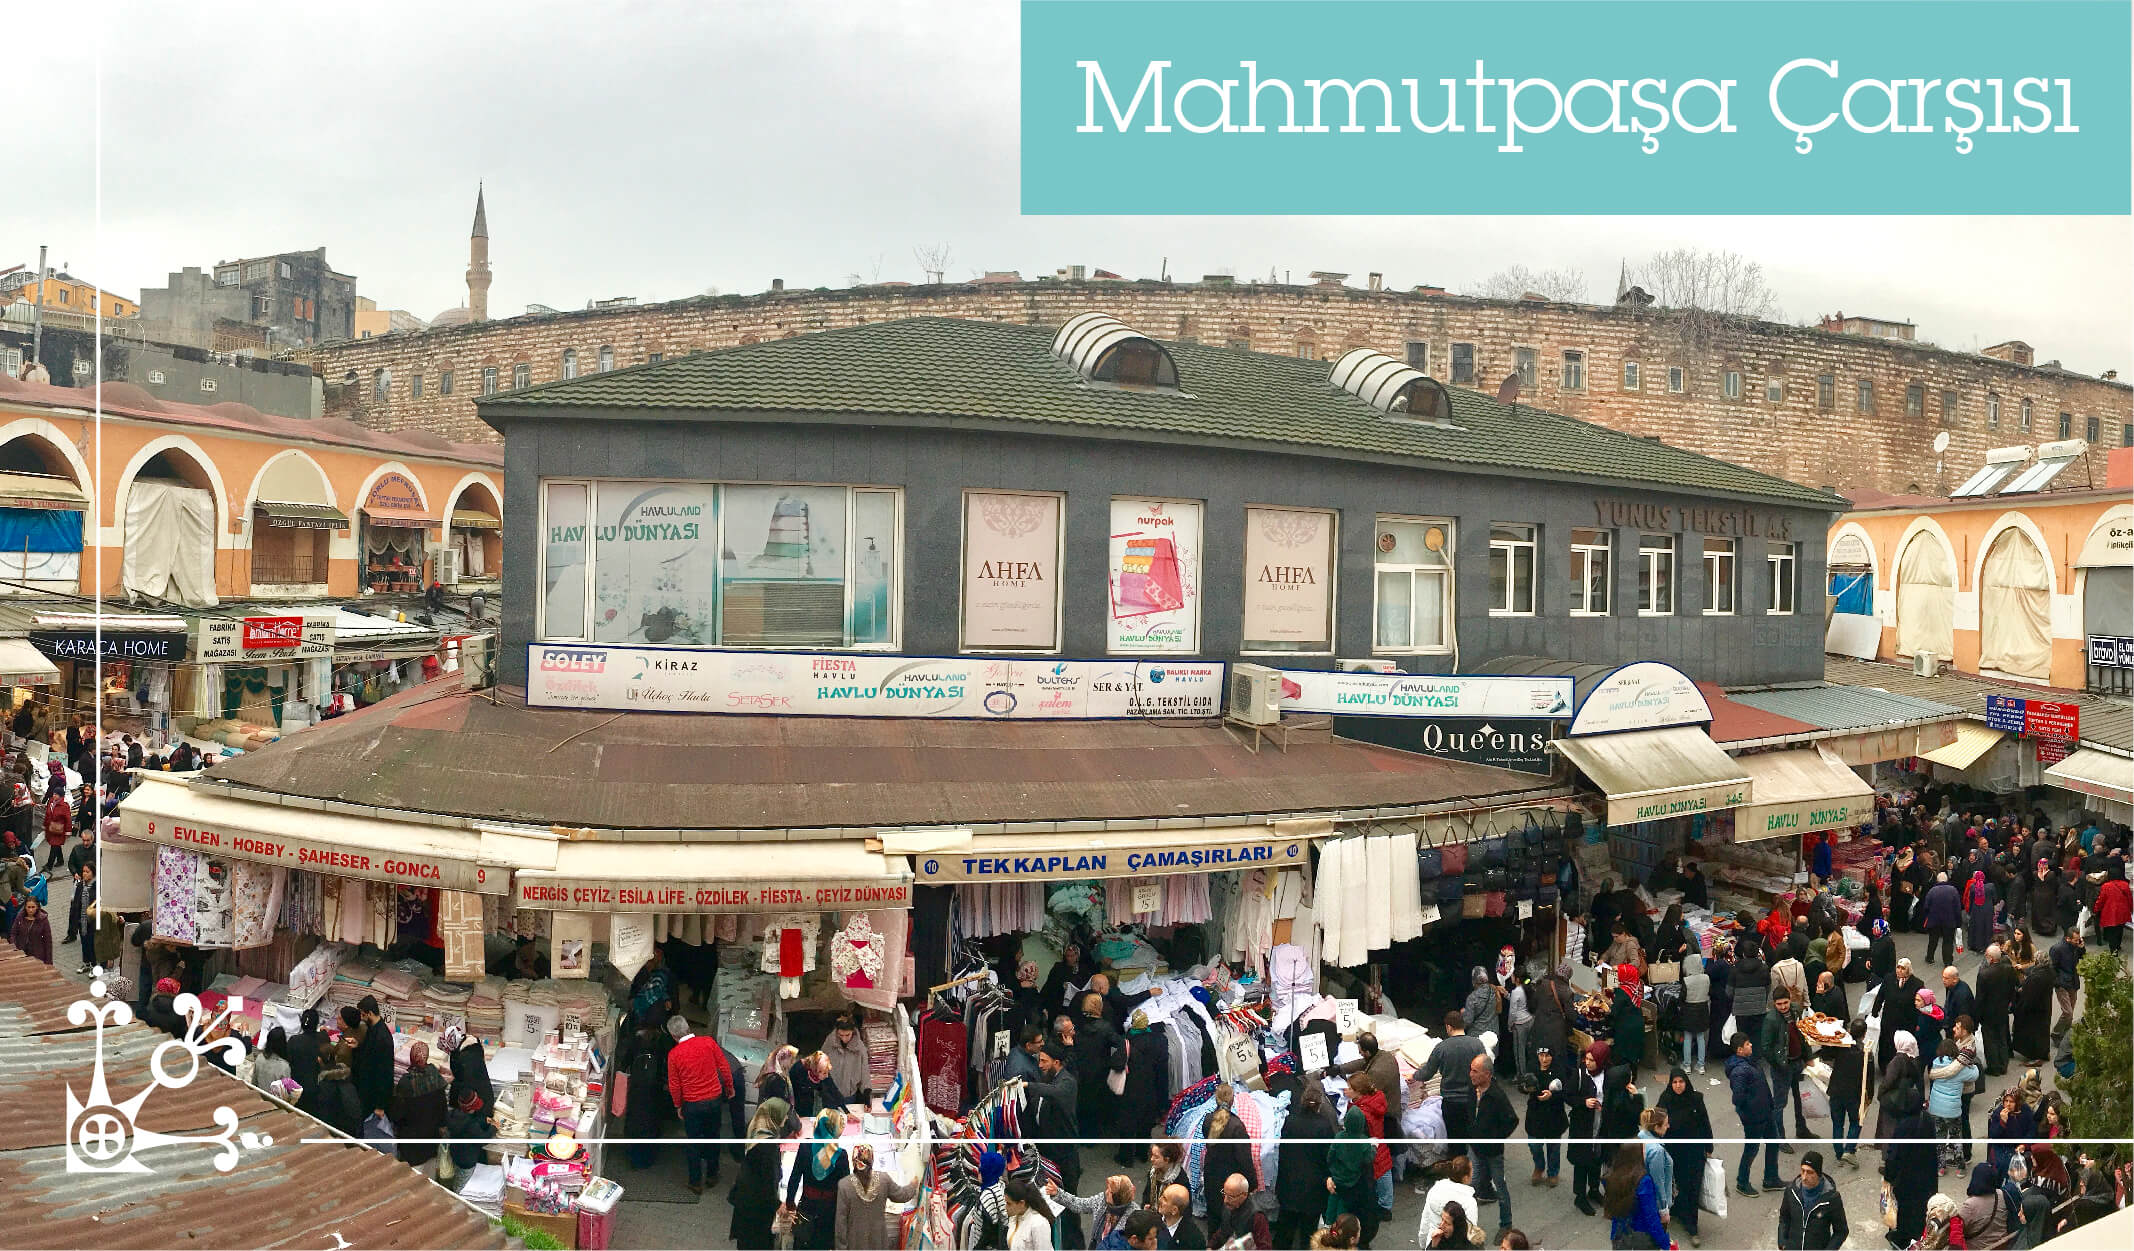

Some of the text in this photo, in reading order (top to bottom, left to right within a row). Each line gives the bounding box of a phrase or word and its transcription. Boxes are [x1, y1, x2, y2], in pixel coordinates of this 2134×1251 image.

[640, 506, 701, 517] HAVLULAND
[1594, 500, 1673, 529] YUNUS
[1679, 506, 1760, 537] TEKSTİL
[1137, 516, 1175, 528] nurpak
[623, 519, 700, 541] DÜNYASI
[976, 560, 1043, 581] AHFA
[1258, 564, 1317, 585] AHFA
[992, 580, 1026, 588] HOME
[1271, 584, 1301, 592] HOME
[209, 623, 236, 632] FABRİKA
[212, 636, 231, 645] SATIŞ
[1119, 634, 1146, 642] HAVLU
[55, 639, 169, 656] KARACA HOME
[203, 649, 237, 658] MAĞAZASI
[544, 652, 604, 671] SOLEY
[655, 659, 698, 671] KİRAZ
[812, 656, 857, 671] FİESTA
[812, 672, 857, 680] HAVLU
[904, 673, 967, 682] HAVLULAND
[816, 683, 965, 700] HAVLU DÜNYASI
[1092, 682, 1113, 692] SER
[1114, 683, 1123, 691] &
[1400, 683, 1460, 694] HAVLULAND
[1157, 694, 1191, 707] TEKSTİL
[1193, 696, 1212, 707] GIDA
[1337, 691, 1459, 708] HAVLU DÜNYASI
[1422, 723, 1544, 754] Queens
[1636, 803, 1667, 819] HAVLU
[1669, 797, 1708, 815] DÜNYASI
[1767, 807, 1849, 831] HAVLU DÜNYASI
[147, 822, 487, 884] 9 EVLEN HOBBY ŞAHESER GONCA 9
[926, 845, 1297, 874] 10 TEK KAPLAN ÇAMAŞIRLARI 10
[522, 883, 569, 903] NERGİS
[618, 883, 655, 905] ESİLA
[657, 884, 685, 906] LİFE
[695, 884, 750, 906] ÖZDİLEK
[760, 885, 803, 905] FİESTA
[815, 885, 852, 907] ÇEYİZ
[855, 885, 907, 902] DÜNYASI
[1236, 1050, 1247, 1063] 5
[1309, 1049, 1319, 1064] 5
